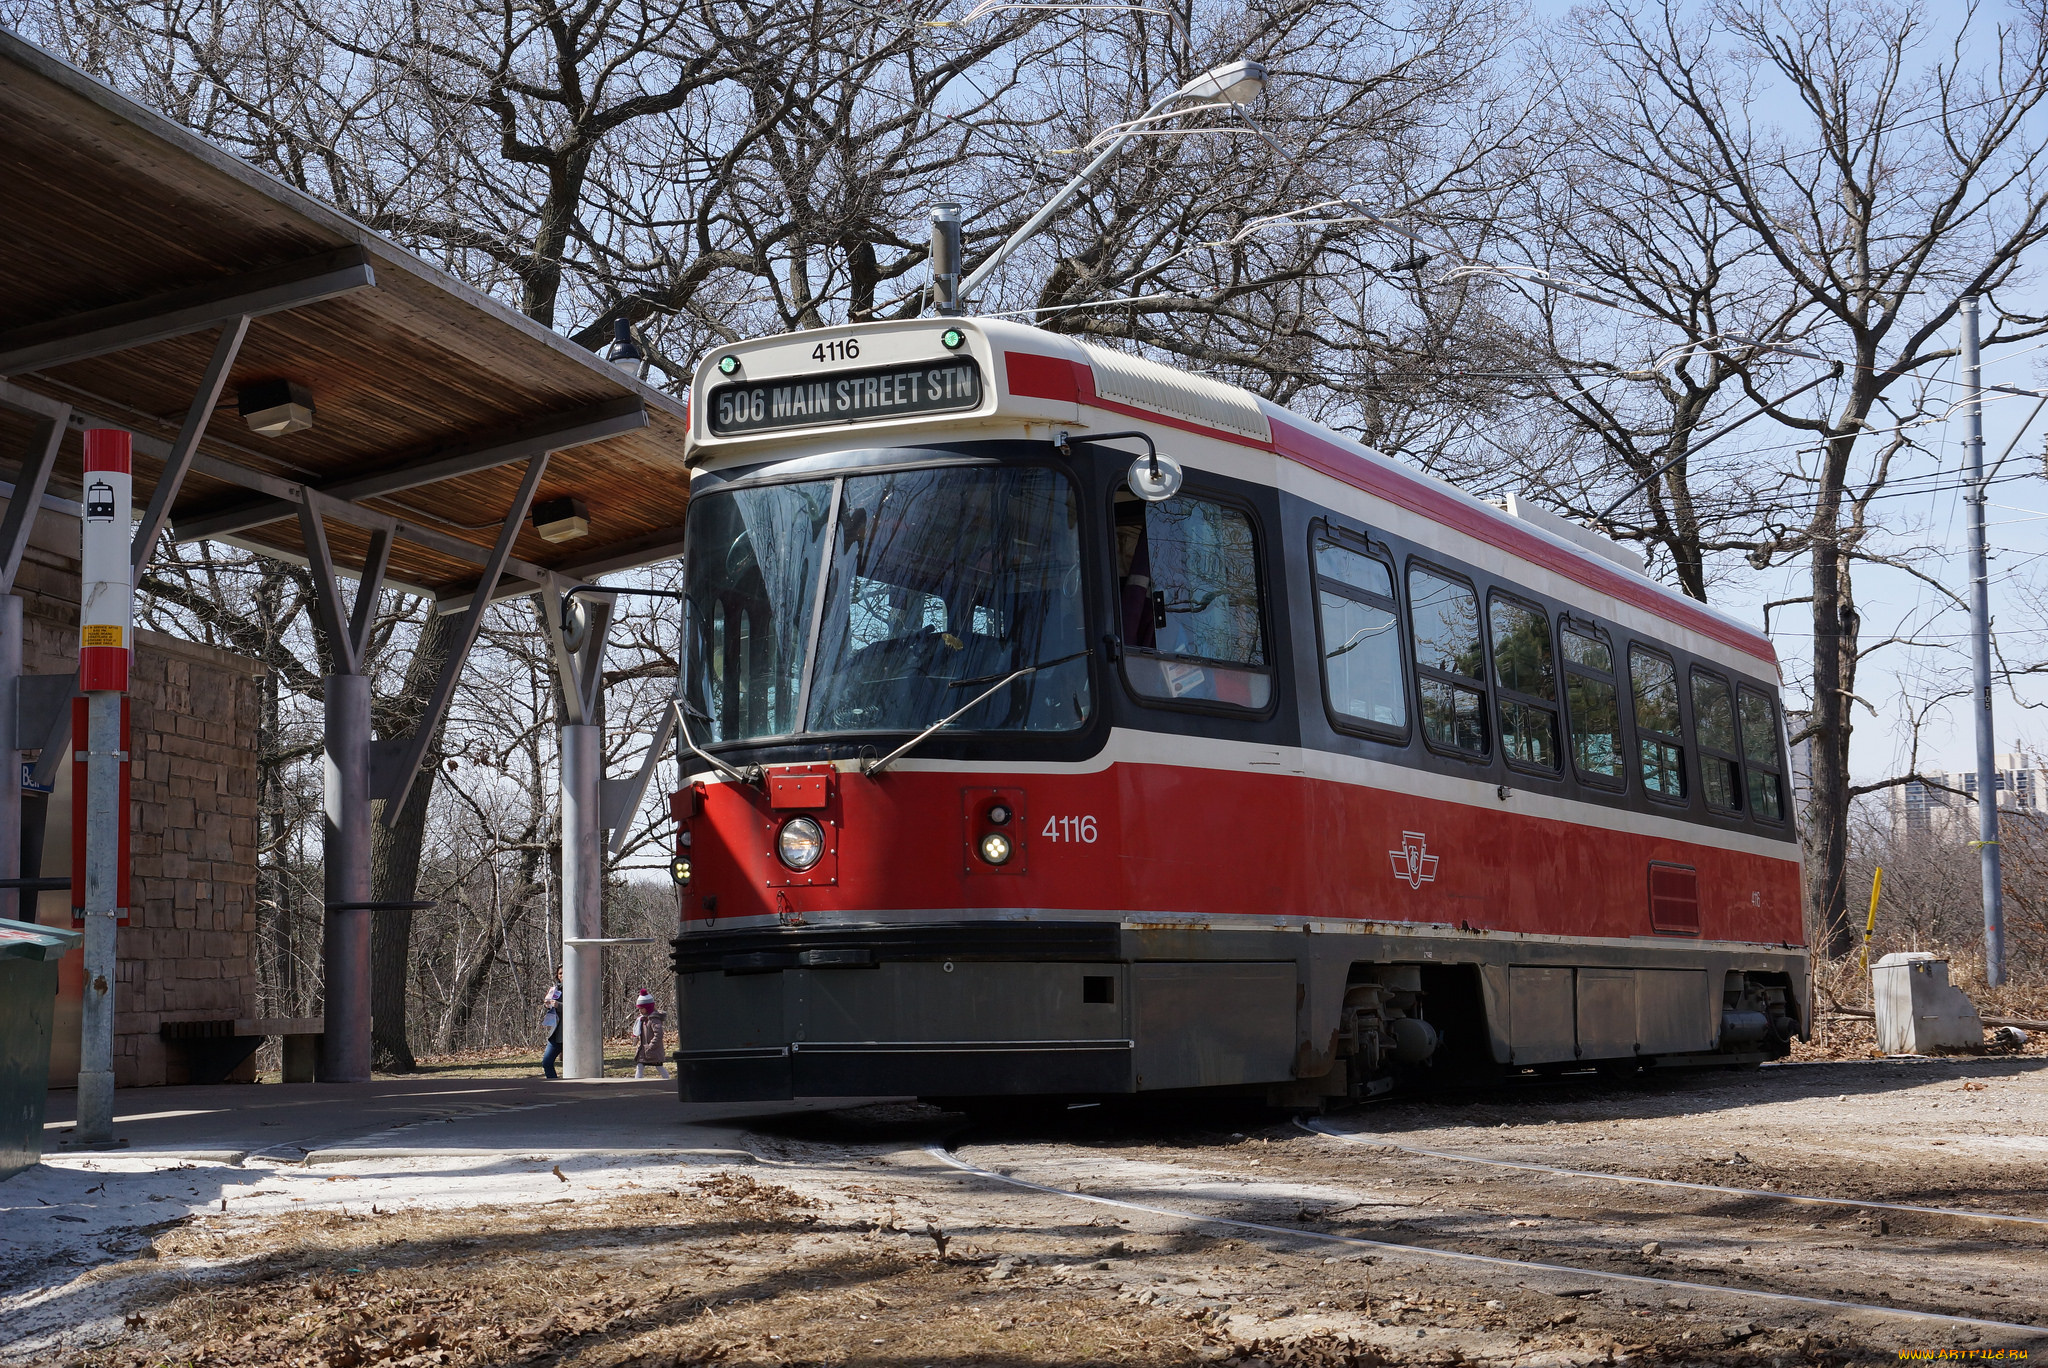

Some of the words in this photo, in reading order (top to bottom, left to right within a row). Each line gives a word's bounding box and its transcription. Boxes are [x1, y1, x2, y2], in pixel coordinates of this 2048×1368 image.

[811, 338, 860, 363] 4116
[719, 388, 765, 425] 506
[772, 383, 830, 418] MAIN
[836, 371, 923, 411] STREET
[928, 366, 972, 401] STN
[1042, 815, 1098, 844] 4116
